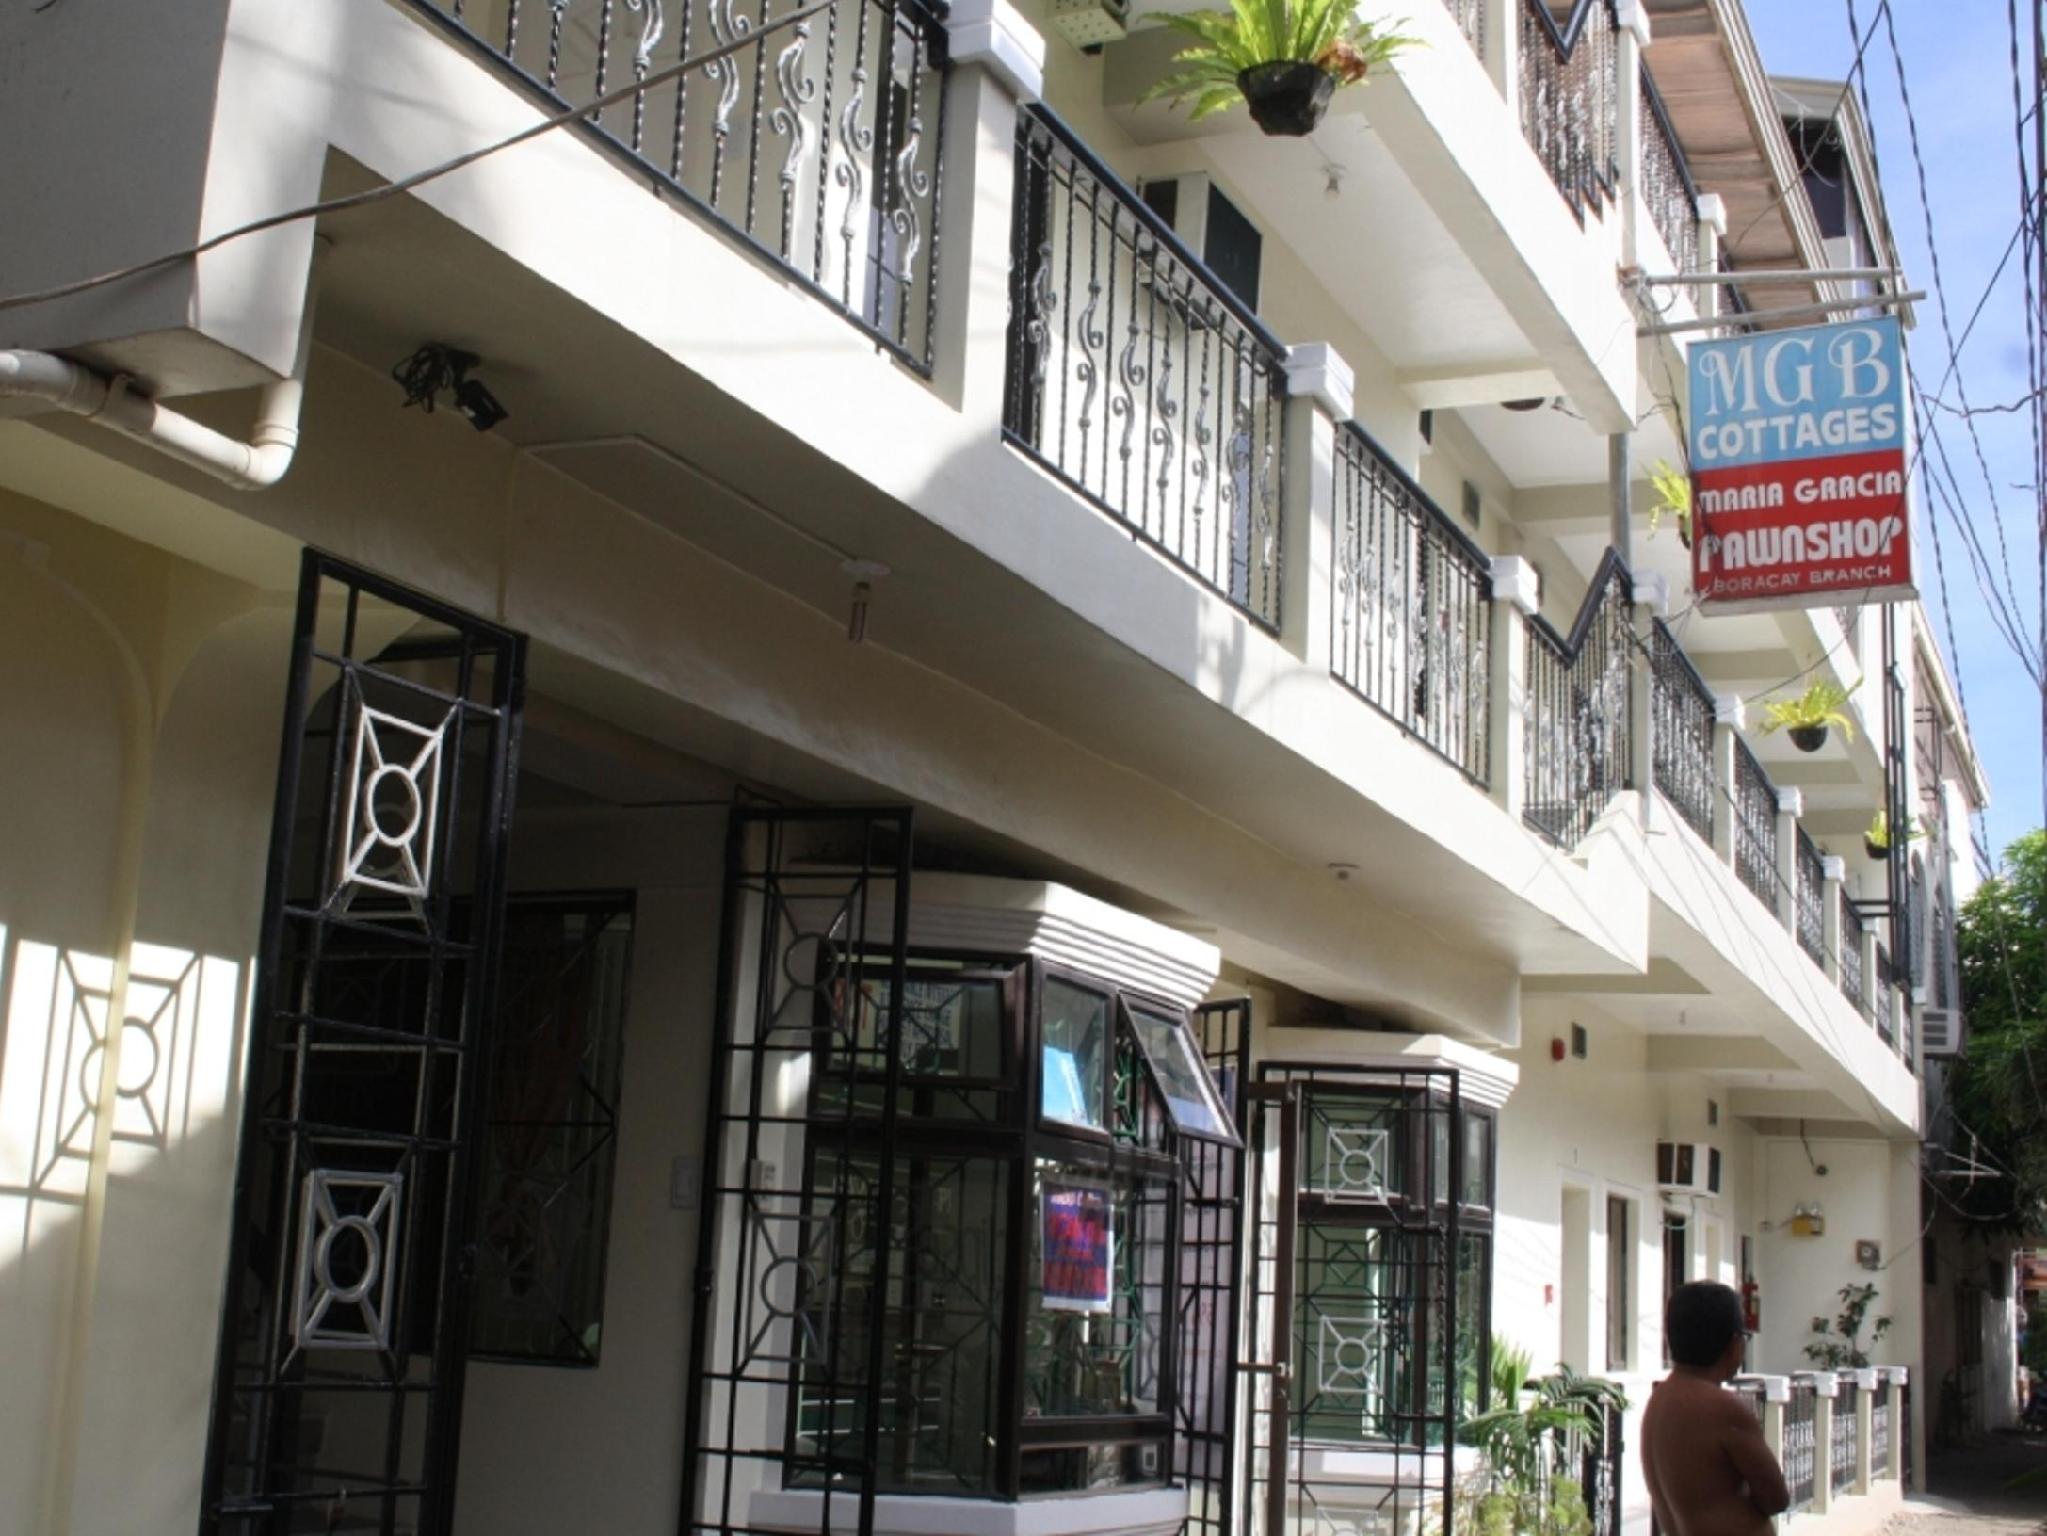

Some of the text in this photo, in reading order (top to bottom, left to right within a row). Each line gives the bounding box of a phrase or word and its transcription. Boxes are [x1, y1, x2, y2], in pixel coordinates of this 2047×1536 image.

[1697, 403, 1897, 460] COTTAGES
[1699, 482, 1784, 514] MARIA
[1699, 516, 1903, 572] PAWNSHOP
[1713, 565, 1892, 593] BORACAY BRANCH
